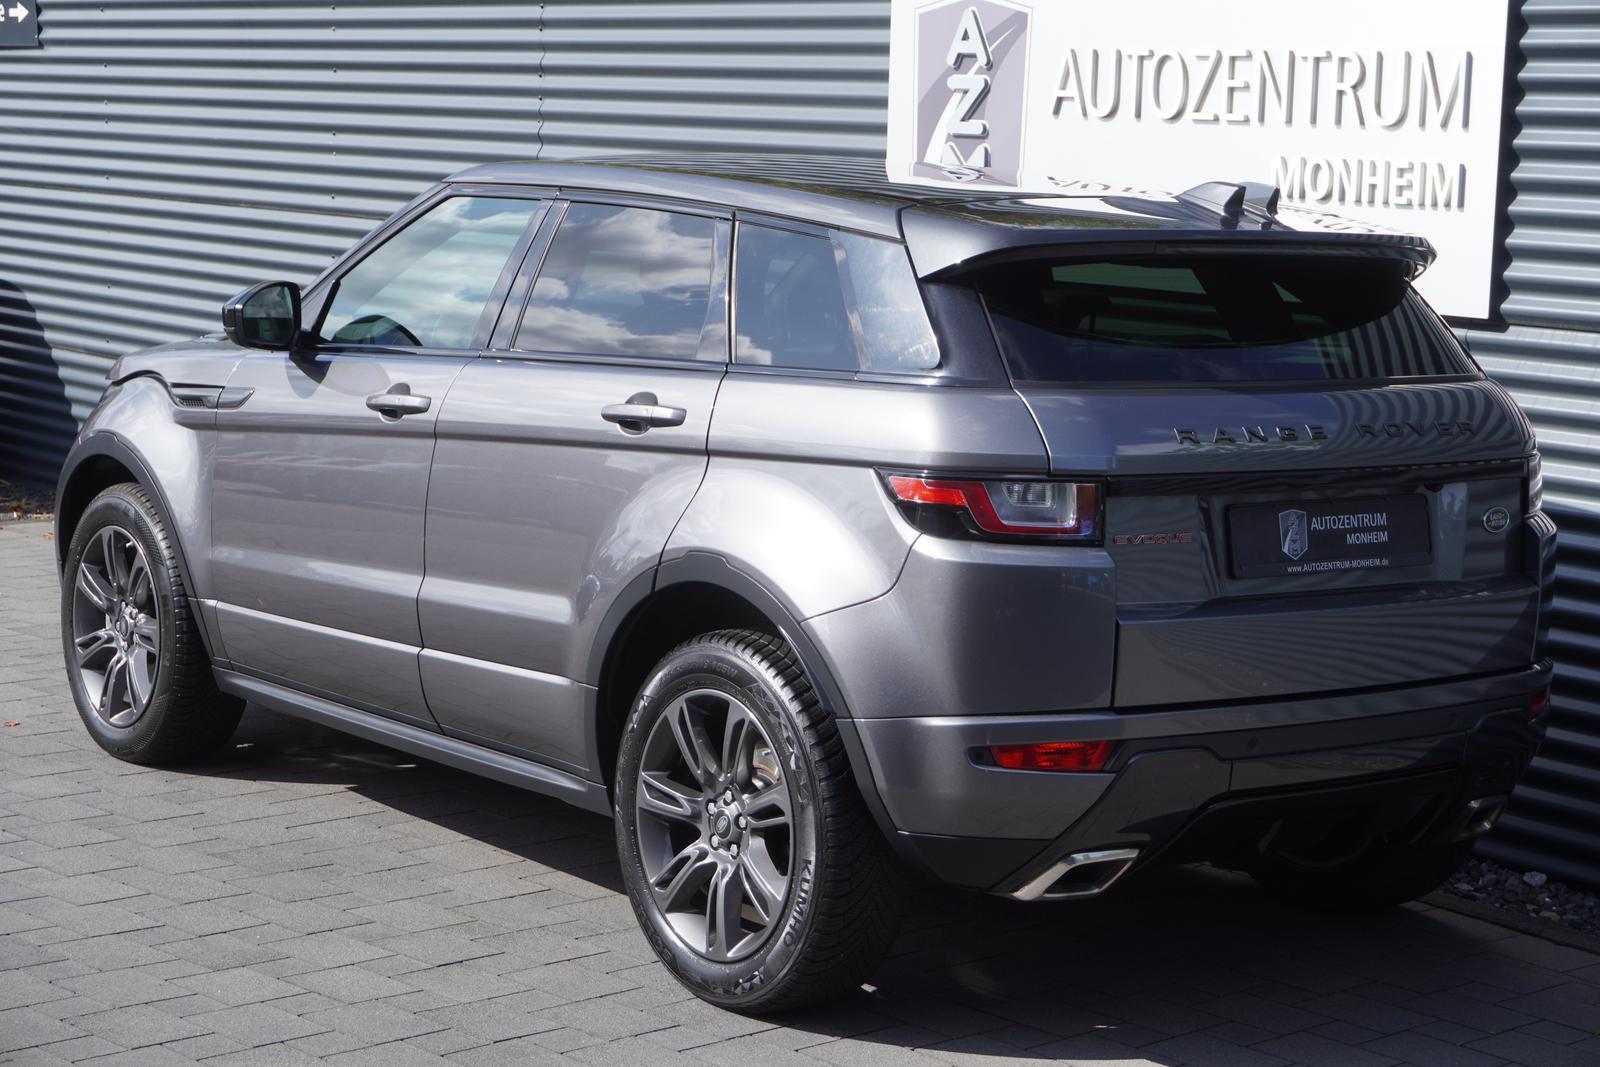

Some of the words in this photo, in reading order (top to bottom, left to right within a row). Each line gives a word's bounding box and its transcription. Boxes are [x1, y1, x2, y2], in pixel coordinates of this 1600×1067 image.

[1052, 47, 1474, 131] AUTOZENTRUM
[1272, 155, 1467, 210] MONHEIM
[1173, 424, 1329, 445] RANGE
[1355, 420, 1476, 438] ROVER
[1310, 512, 1388, 531] AUTOZENTRUM
[1346, 531, 1389, 545] MONHEIM
[1287, 558, 1389, 573] www.AUTOZENTRUM-MONHEIM.de
[783, 858, 812, 947] KUMHO
